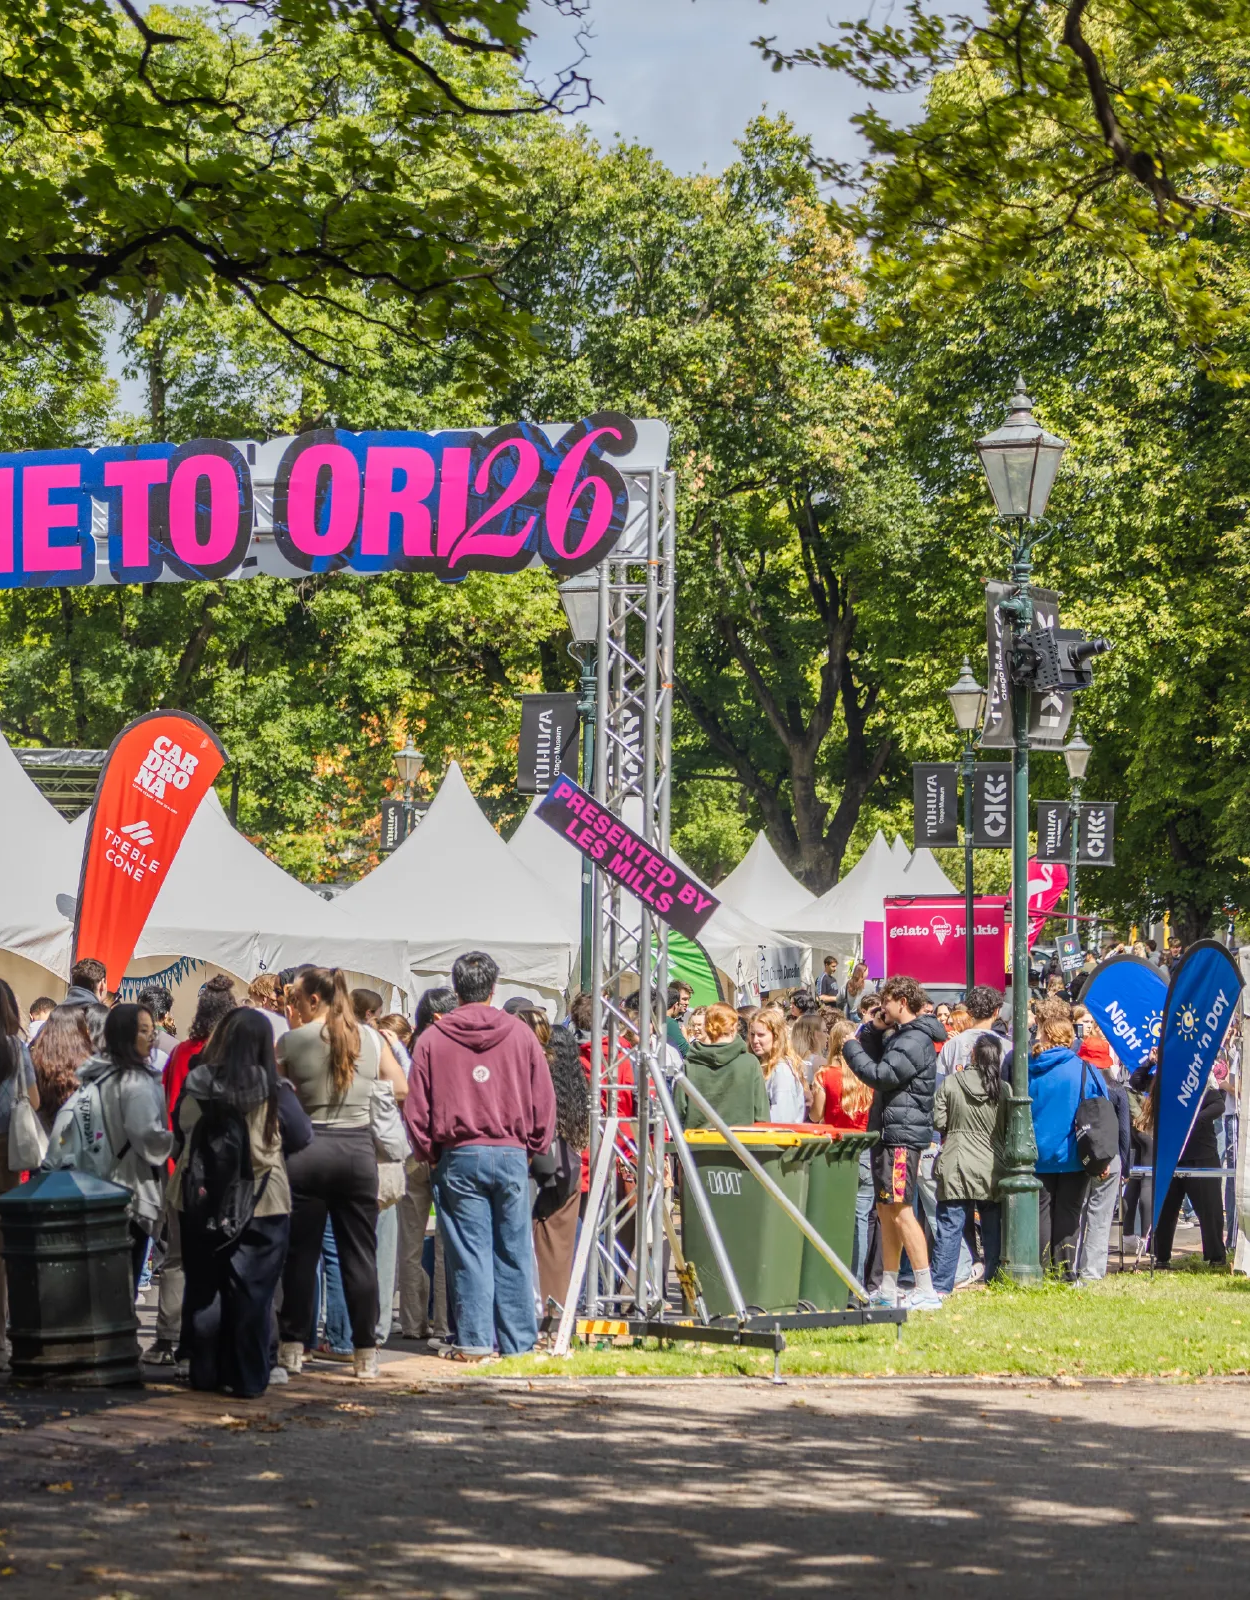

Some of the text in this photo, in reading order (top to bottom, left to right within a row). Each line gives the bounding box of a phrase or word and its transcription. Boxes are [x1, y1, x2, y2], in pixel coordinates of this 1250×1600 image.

[104, 454, 240, 568] TO
[287, 427, 623, 569] ORI26
[142, 749, 190, 791] DRO
[153, 735, 199, 776] CAR
[133, 765, 167, 800] NA
[103, 827, 161, 874] TREBLE
[105, 848, 145, 882] CONE
[554, 782, 712, 914] PRESENTED BY
[564, 818, 674, 913] LES MILLS
[889, 925, 930, 938] gelato
[1104, 1000, 1143, 1050] Night
[1177, 1053, 1204, 1108] Night
[1205, 988, 1230, 1032] Day
